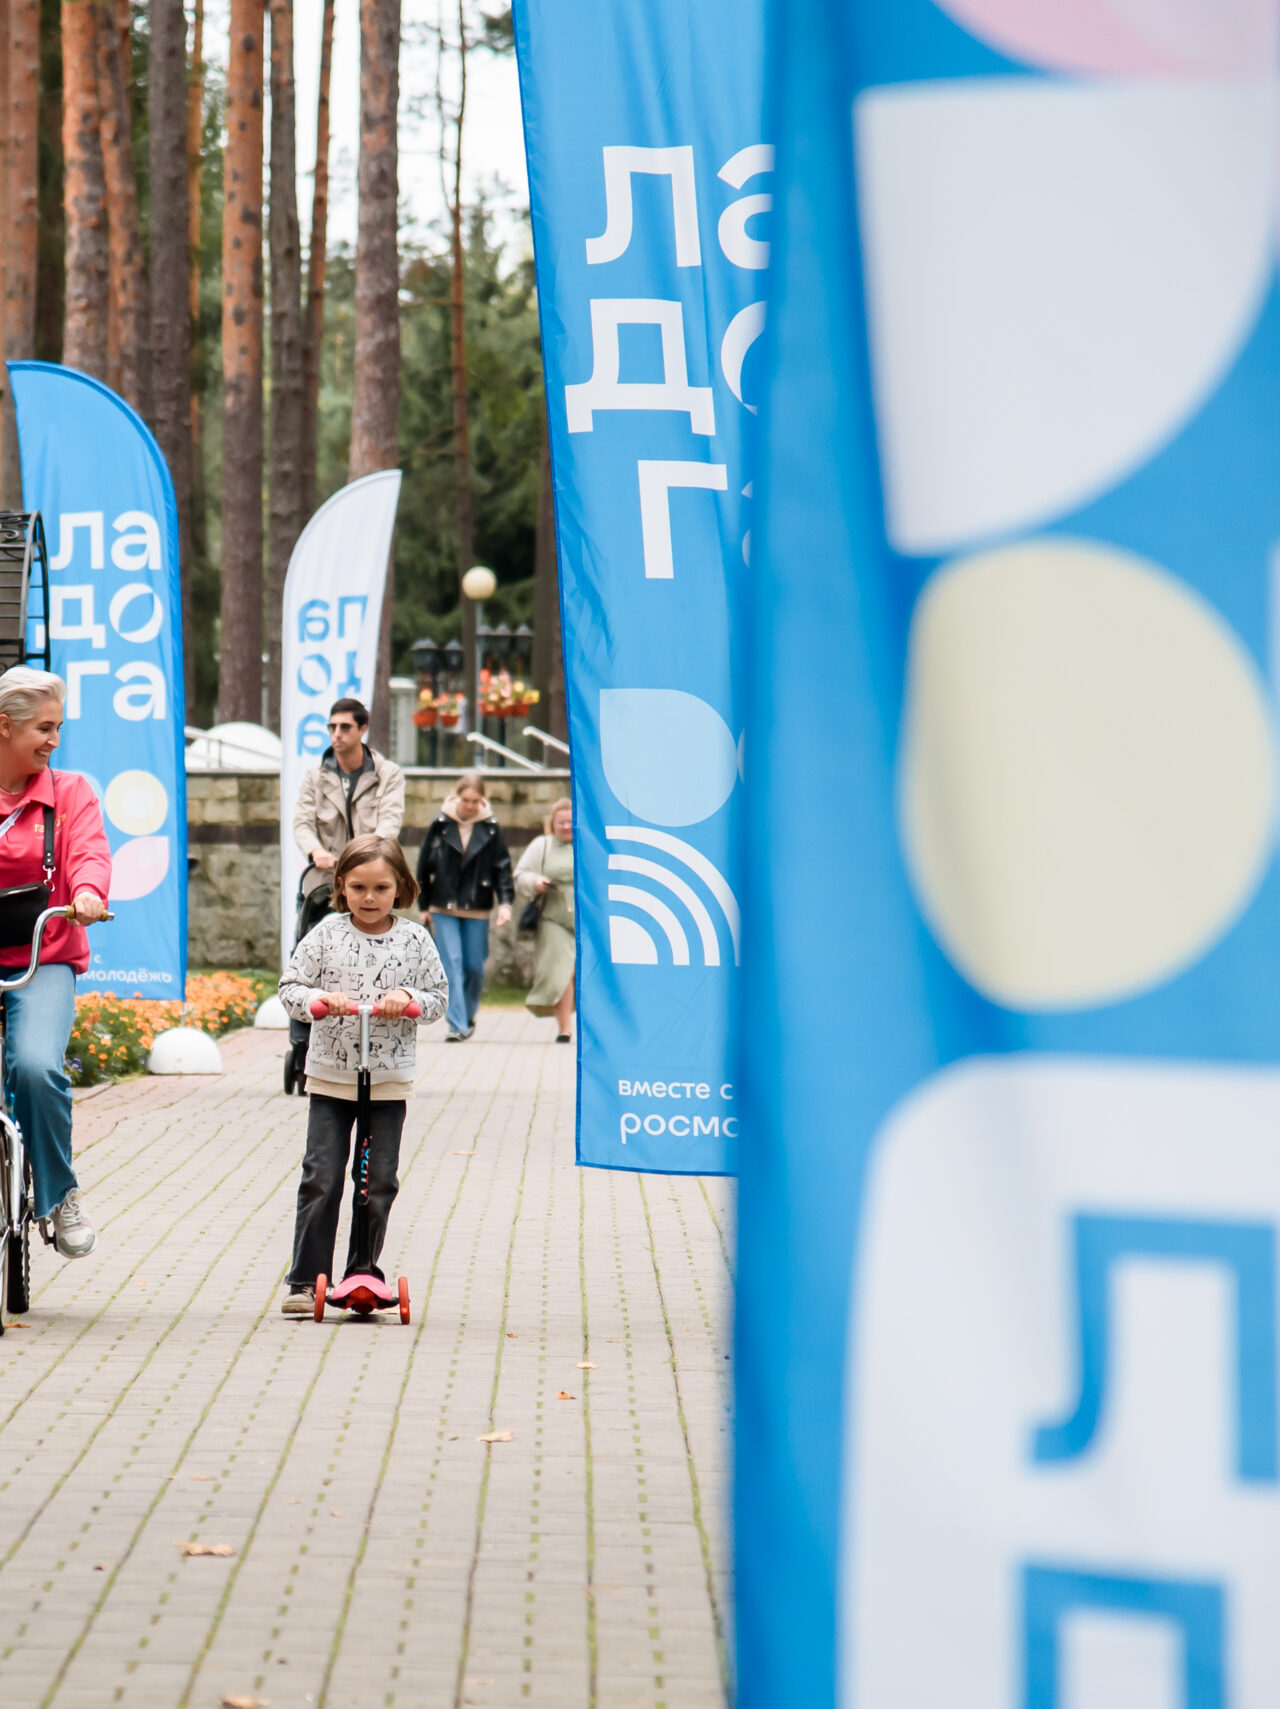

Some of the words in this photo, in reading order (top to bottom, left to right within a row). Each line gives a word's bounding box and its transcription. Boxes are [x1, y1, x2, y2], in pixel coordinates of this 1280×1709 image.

[50, 510, 162, 571] ла
[36, 583, 164, 649] до
[66, 660, 167, 721] га
[76, 968, 172, 984] молодёжь
[618, 1079, 710, 1100] вместе
[720, 1083, 733, 1100] с
